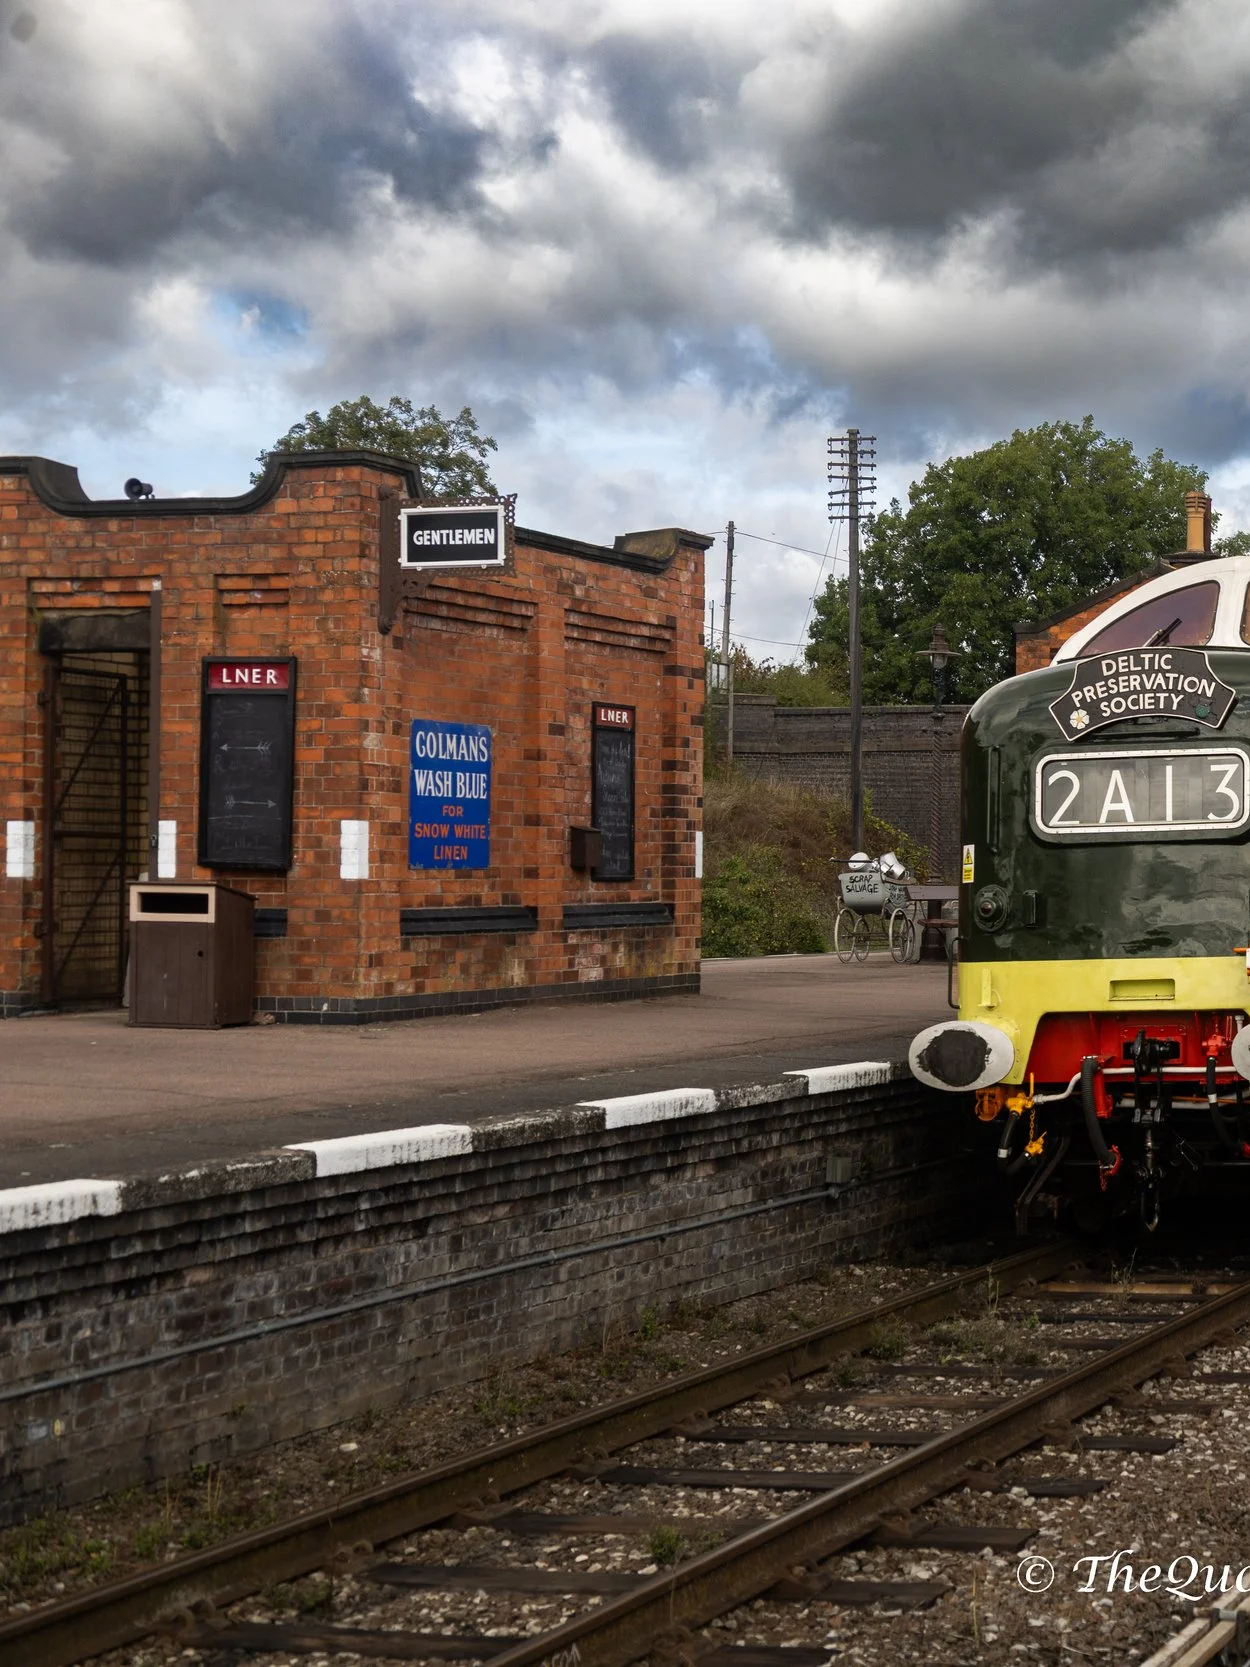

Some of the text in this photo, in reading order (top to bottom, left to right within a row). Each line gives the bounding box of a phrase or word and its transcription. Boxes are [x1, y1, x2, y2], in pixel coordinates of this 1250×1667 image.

[413, 528, 495, 545] GENTLEMEN
[1102, 654, 1173, 676] DELTIC
[222, 667, 277, 684] LNER
[1071, 672, 1216, 708] PRESERVATION
[1100, 693, 1185, 717] SOCIETY
[600, 708, 629, 724] LNER
[415, 730, 489, 763] COLMAN'S
[413, 769, 488, 799] WASH BLUE
[442, 805, 464, 818] FOR
[414, 822, 486, 840] SNOW WHITE
[433, 845, 468, 860] LINEN
[849, 874, 873, 883] SCRAP
[845, 883, 879, 894] SALVAGE
